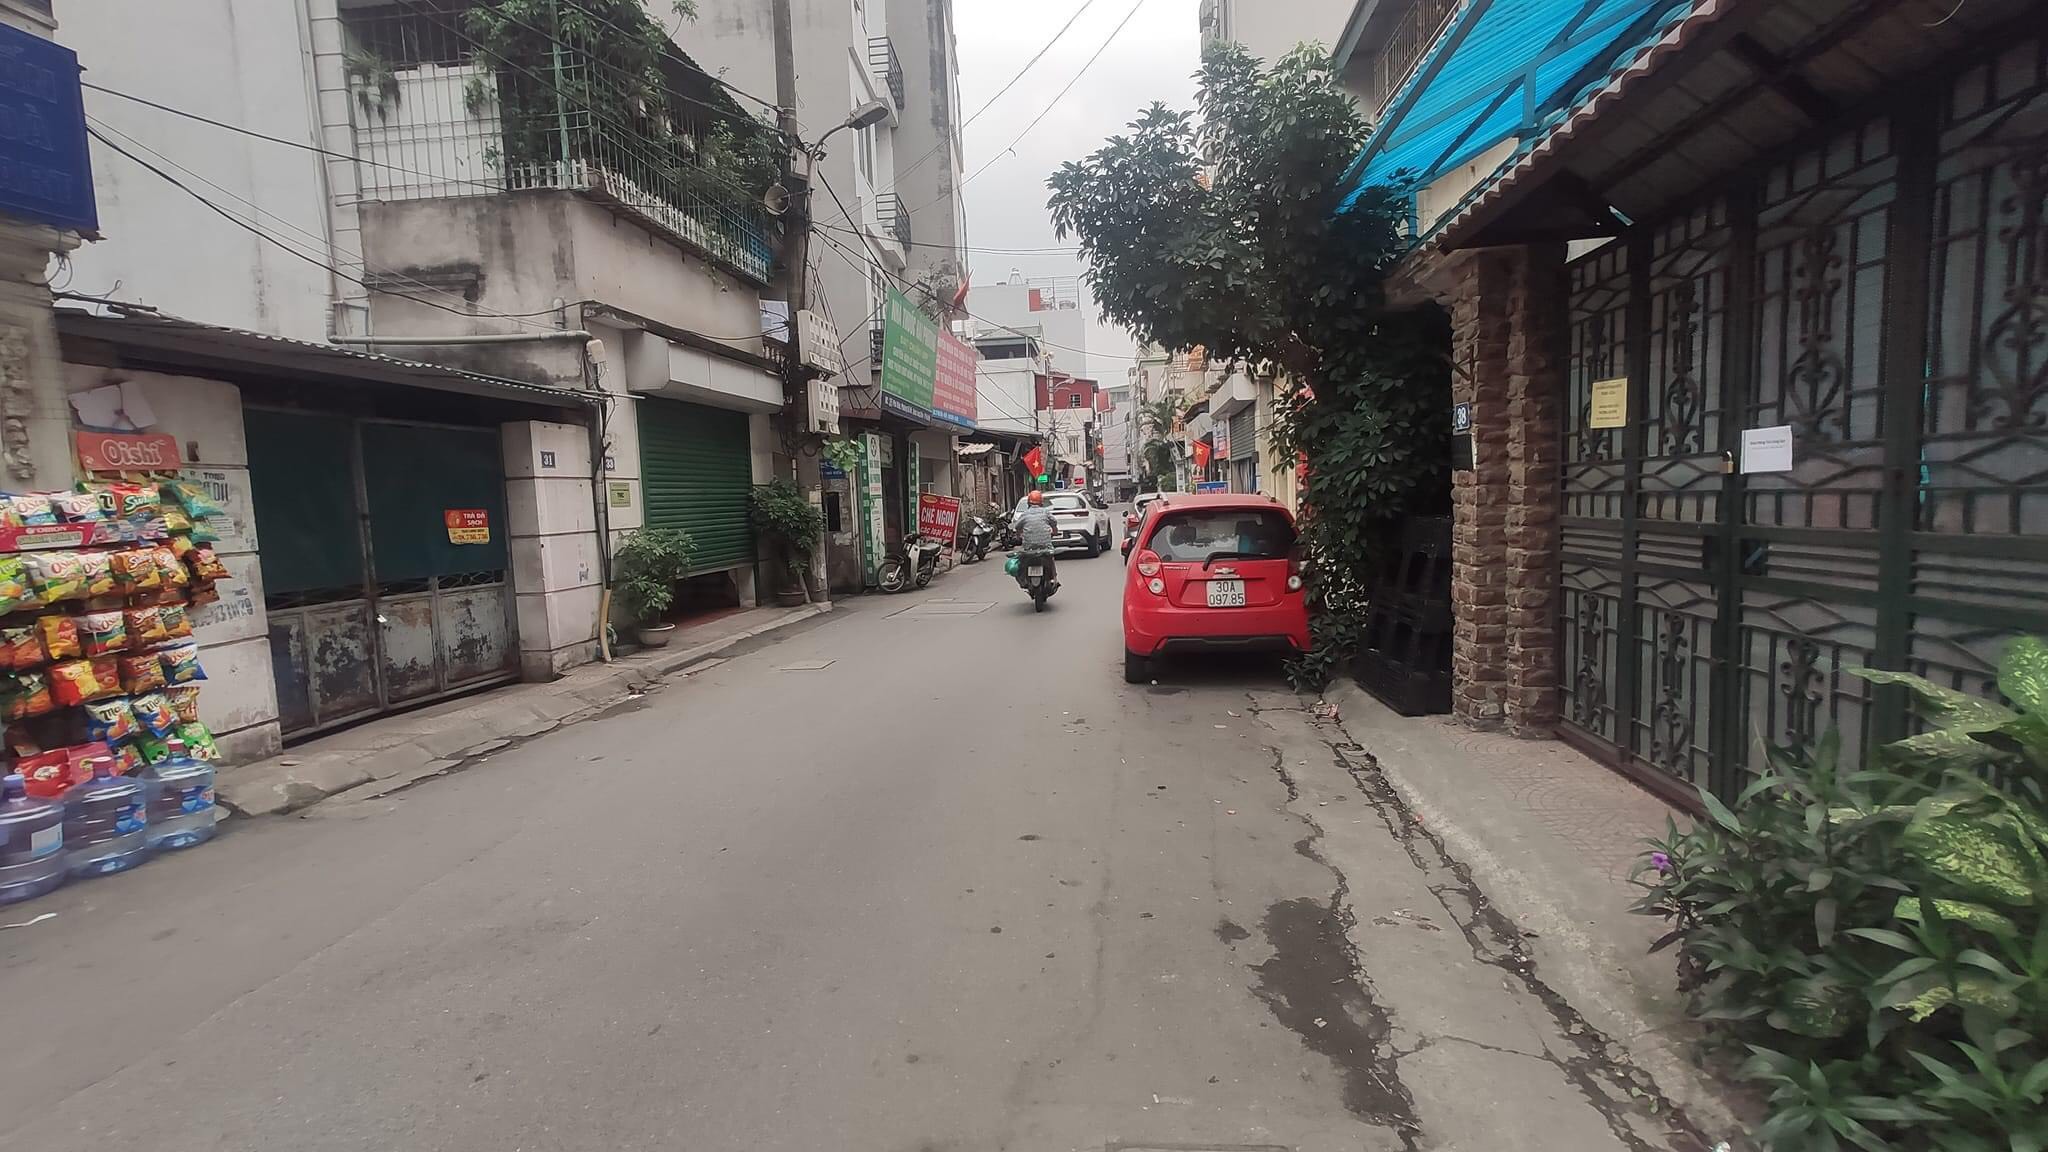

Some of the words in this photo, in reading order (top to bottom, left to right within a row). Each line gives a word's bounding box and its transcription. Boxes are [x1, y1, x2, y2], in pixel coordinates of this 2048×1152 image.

[1457, 407, 1467, 425] 38
[101, 439, 163, 466] Oishi
[543, 454, 553, 466] 31
[921, 505, 935, 524] CHÈ
[936, 510, 955, 527] NGON
[1216, 581, 1236, 593] 30A
[1209, 593, 1244, 606] 097.85
